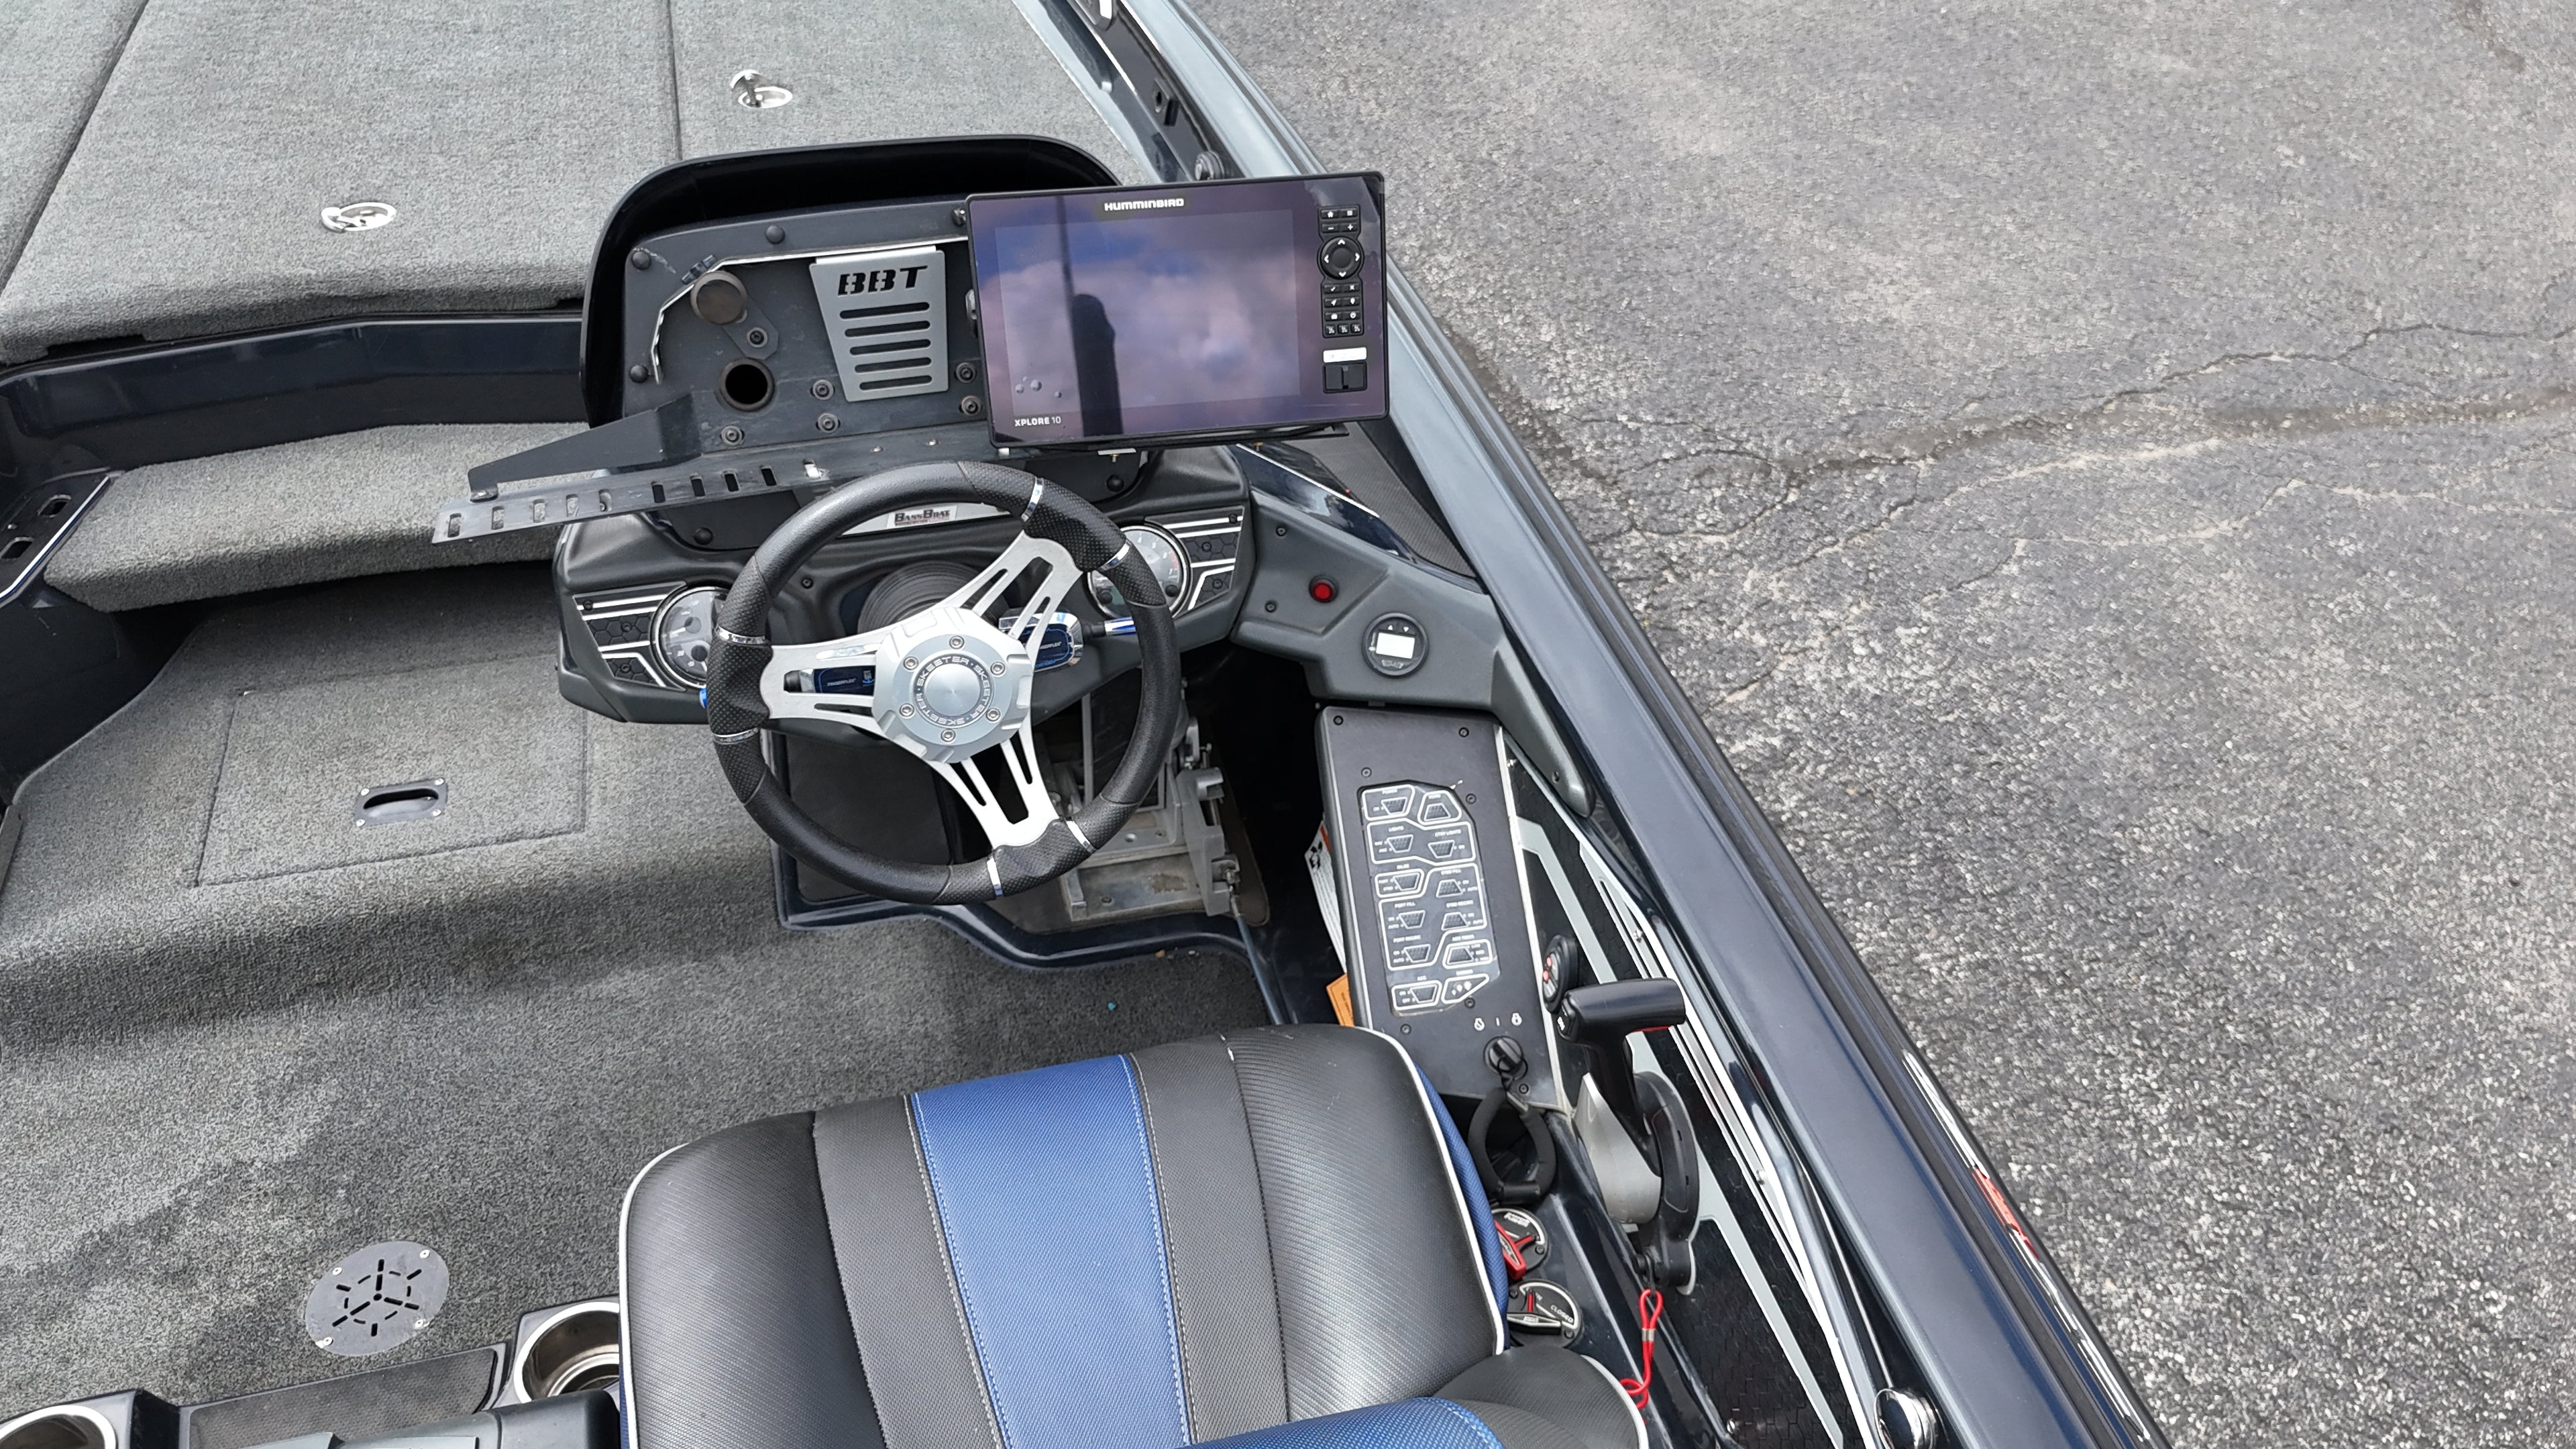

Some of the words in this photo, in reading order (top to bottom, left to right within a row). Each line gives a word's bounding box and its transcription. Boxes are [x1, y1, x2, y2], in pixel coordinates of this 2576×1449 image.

[1104, 199, 1184, 211] HUMMINBIRD
[838, 266, 928, 296] BBT
[1014, 417, 1050, 427] XPLORE
[1051, 416, 1061, 424] 10
[917, 656, 969, 686] SKEETER
[970, 664, 990, 719] SKEETER
[916, 692, 965, 725] SKEETER
[1550, 1305, 1574, 1323] CLOSED
